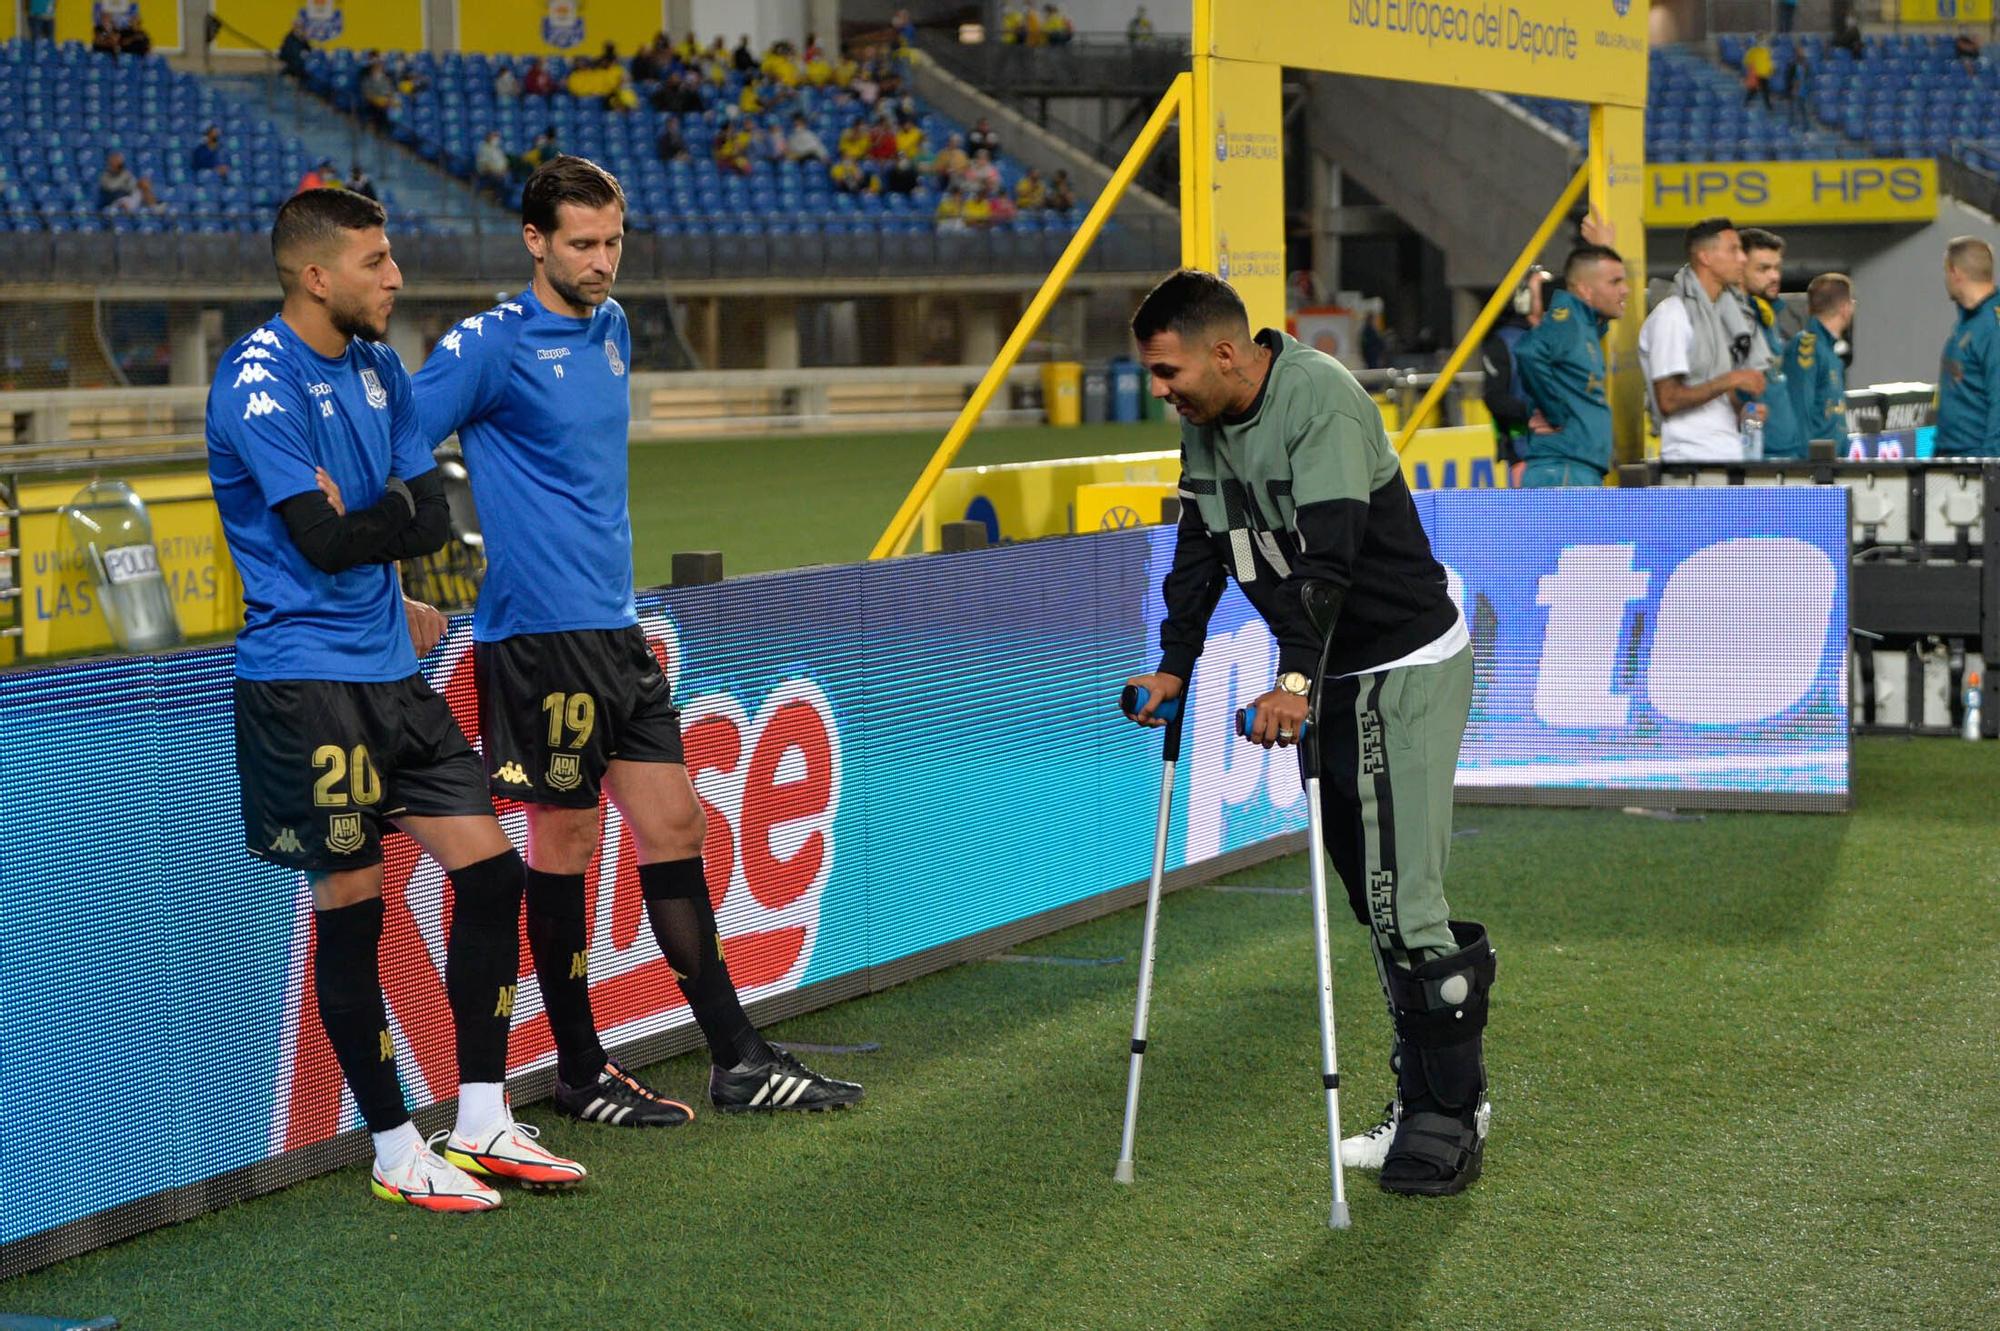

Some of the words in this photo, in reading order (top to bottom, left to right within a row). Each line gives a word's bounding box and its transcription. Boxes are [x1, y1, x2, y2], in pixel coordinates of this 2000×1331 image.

[1386, 0, 1468, 48] Europea
[1472, 3, 1501, 48] del
[1507, 8, 1578, 63] Deporte
[1653, 170, 1769, 207] HPS
[1812, 167, 1923, 203] HPS
[536, 347, 571, 360] Kappa
[553, 364, 564, 379] 19
[36, 581, 92, 621] LAS
[542, 692, 595, 749] 19
[312, 745, 381, 806] 20
